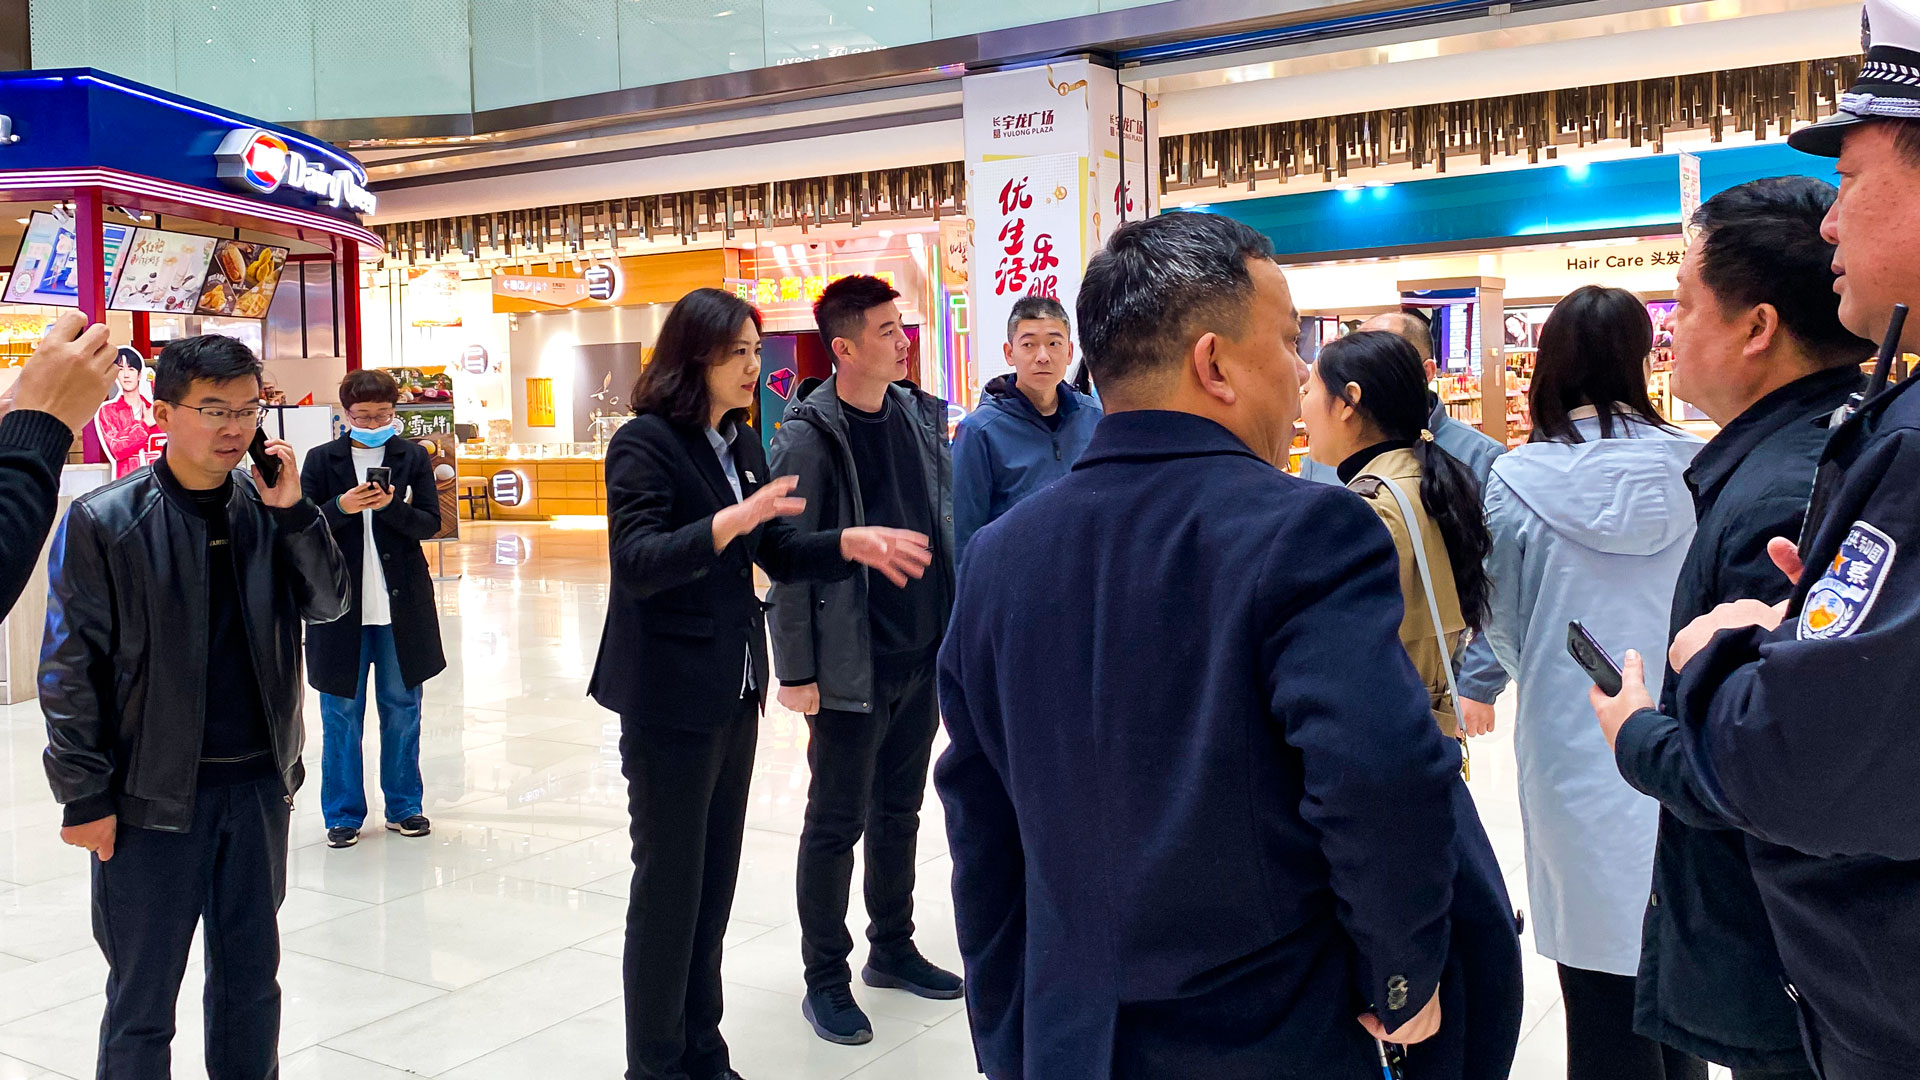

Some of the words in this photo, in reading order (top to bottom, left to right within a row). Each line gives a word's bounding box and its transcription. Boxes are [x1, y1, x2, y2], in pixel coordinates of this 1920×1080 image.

[1002, 109, 1054, 130] 宇龙广场
[1003, 128, 1031, 138] YULONG
[1032, 126, 1054, 135] PLAZA
[288, 150, 341, 208] Dairy
[995, 176, 1033, 296] 优生活
[1567, 258, 1600, 271] Hair
[1606, 255, 1644, 268] Care
[1651, 250, 1686, 266] 头发
